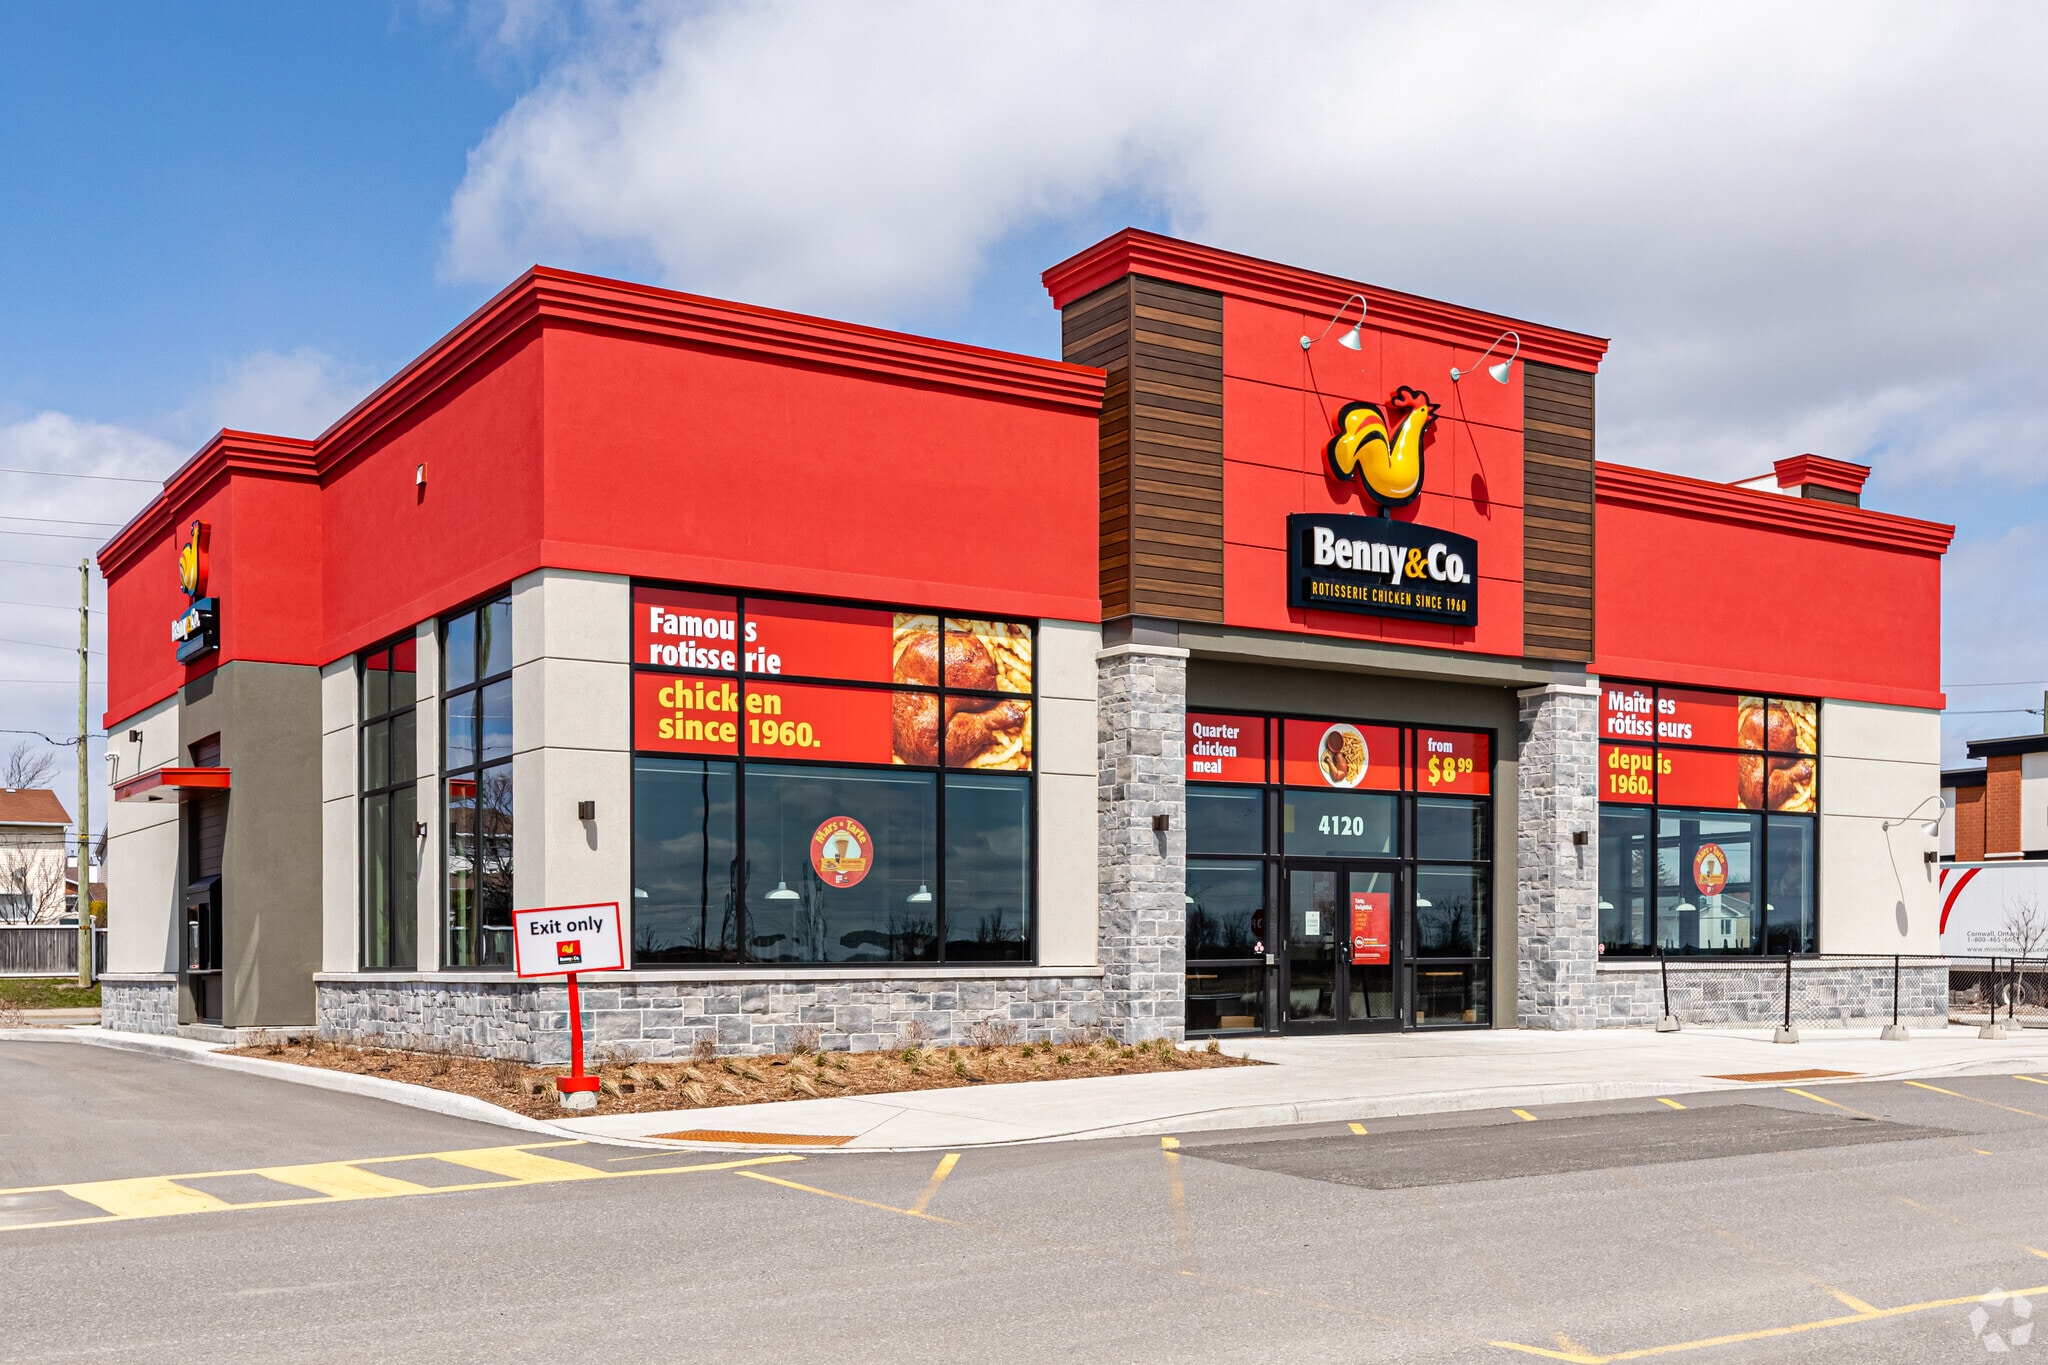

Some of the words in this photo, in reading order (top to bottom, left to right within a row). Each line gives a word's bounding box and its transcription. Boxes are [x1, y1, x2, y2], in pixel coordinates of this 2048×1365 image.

[1312, 581, 1368, 601] ROTISSERIE
[1372, 588, 1412, 606] CHICKEN
[1415, 594, 1442, 610] SINCE
[1446, 597, 1467, 613] 1960
[650, 607, 757, 643] Famous
[650, 641, 781, 675] rotisserie
[658, 679, 782, 715] chicken
[1607, 690, 1676, 715] Maîtres
[658, 711, 738, 743] since
[749, 718, 821, 748] 1960.
[1192, 722, 1240, 740] Quarter
[1607, 712, 1693, 740] rôtisseurs
[1192, 741, 1237, 758] chicken
[1428, 737, 1453, 753] from
[1192, 758, 1222, 774] meal
[1608, 747, 1672, 776] depuis
[1609, 774, 1653, 795] 1960.
[815, 821, 838, 844] Mars
[846, 820, 867, 844] Tarte
[1318, 815, 1364, 837] 4120
[530, 919, 562, 936] Exit
[566, 915, 603, 934] only
